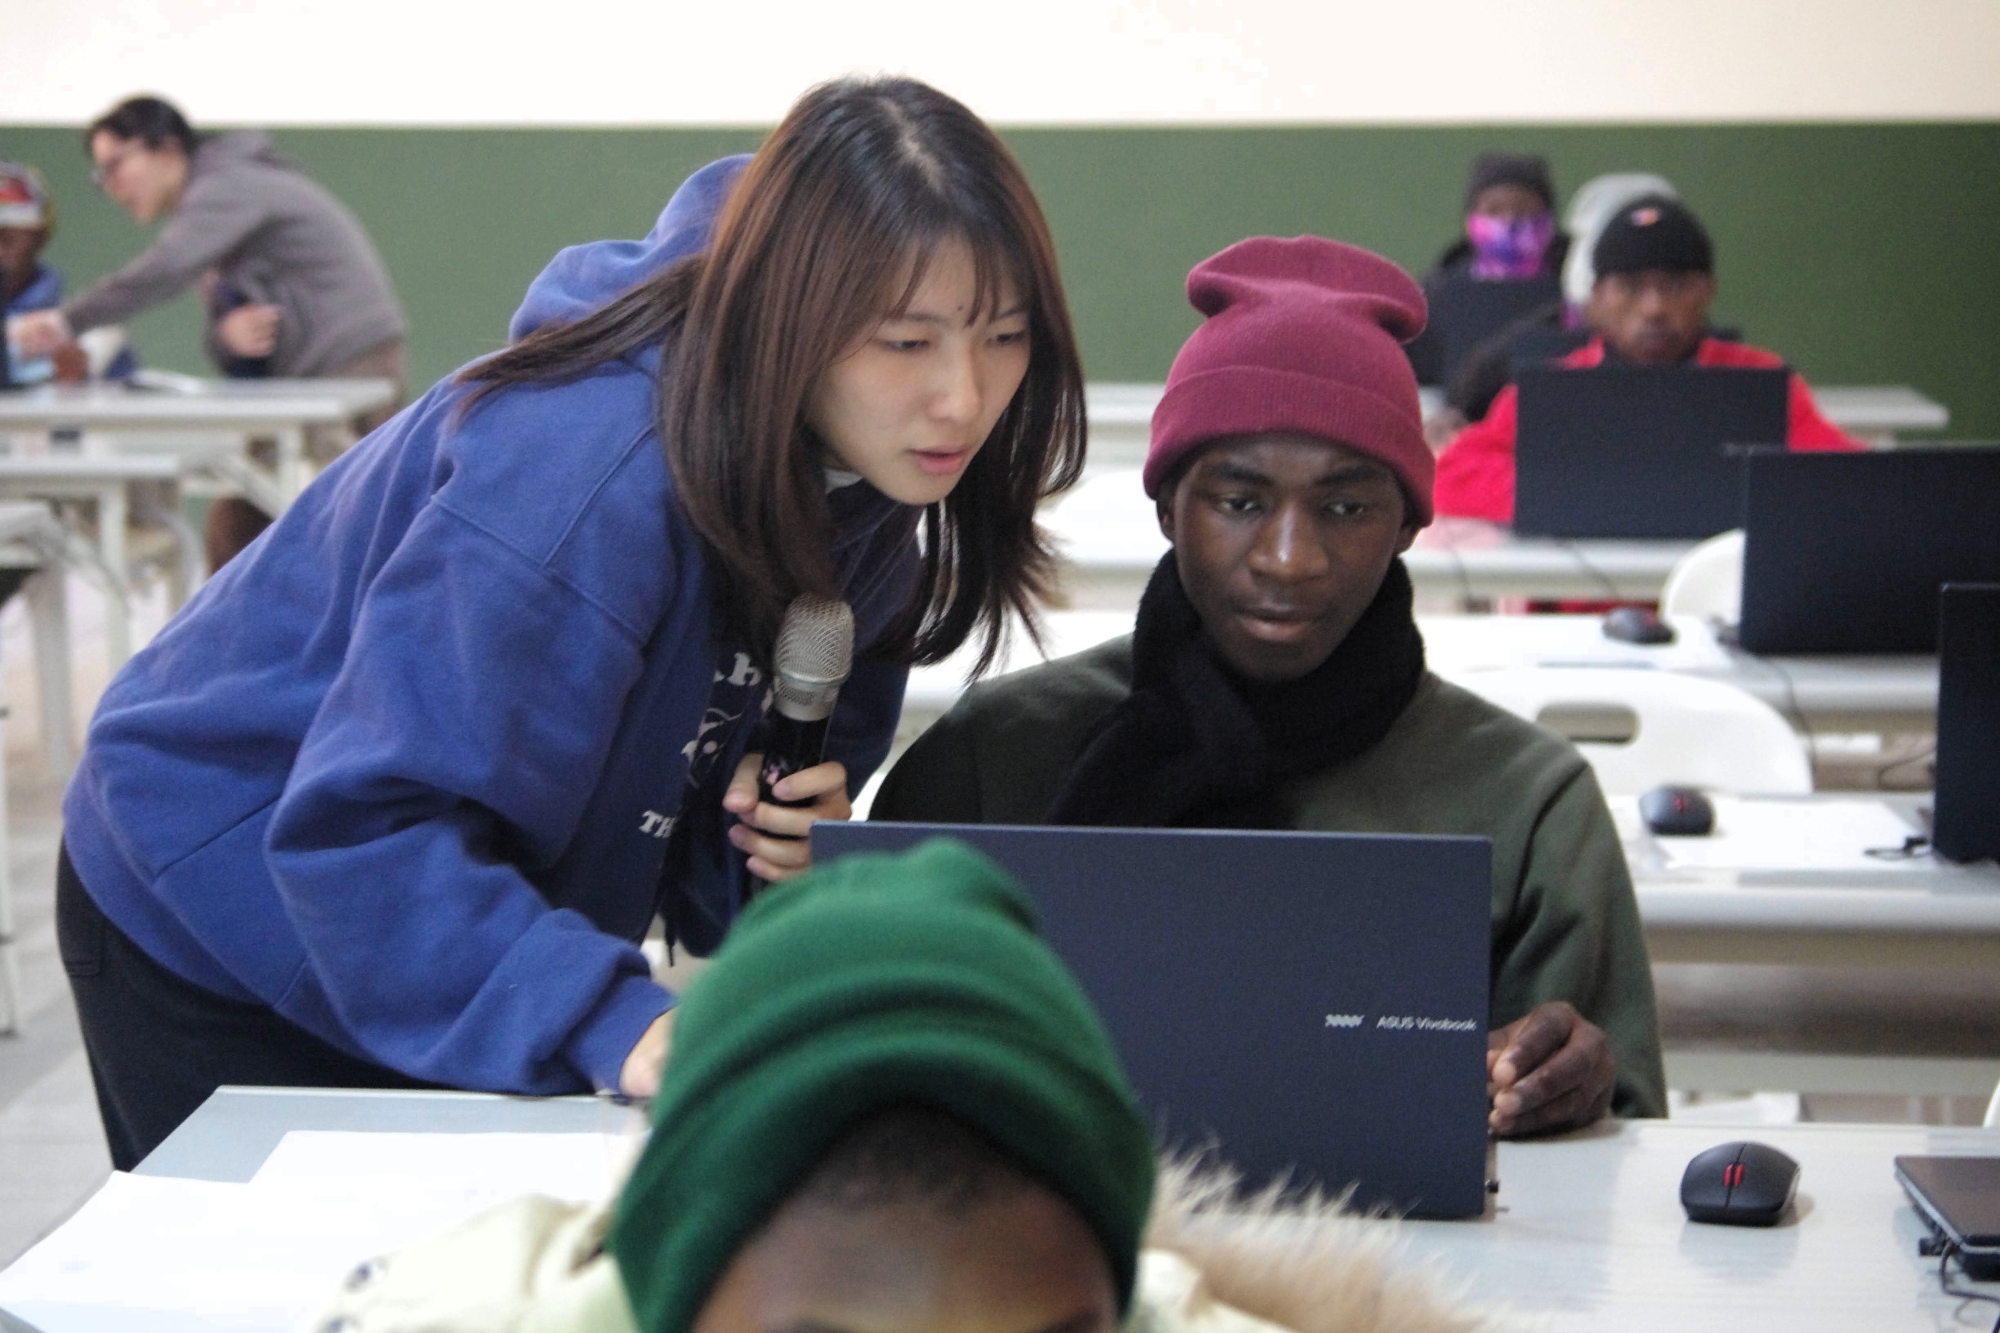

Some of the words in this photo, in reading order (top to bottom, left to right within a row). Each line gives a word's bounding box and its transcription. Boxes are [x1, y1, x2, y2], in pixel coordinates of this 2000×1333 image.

[638, 810, 676, 839] TH
[1376, 1015, 1414, 1030] ASUS
[1416, 1017, 1477, 1032] Vivobook
